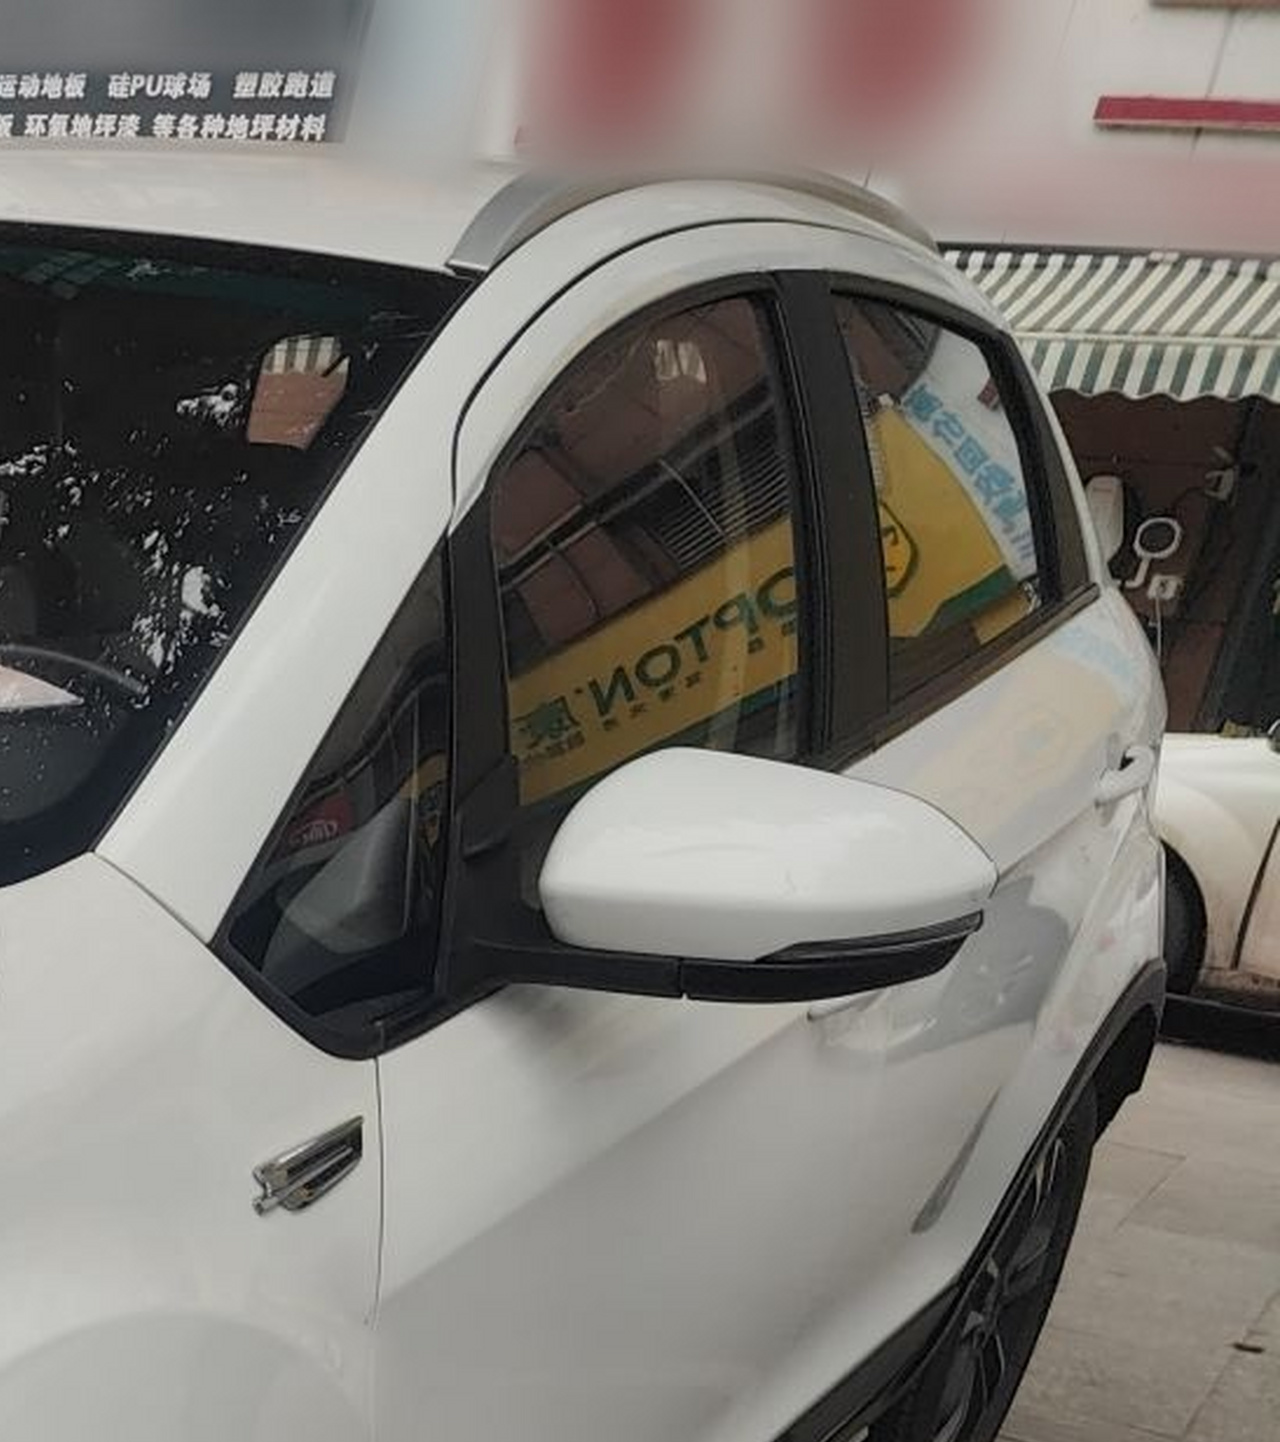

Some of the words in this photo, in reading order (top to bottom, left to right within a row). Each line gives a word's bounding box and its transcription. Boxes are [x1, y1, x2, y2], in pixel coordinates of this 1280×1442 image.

[107, 71, 212, 100] 硅PU球场
[232, 71, 336, 99] 塑胶跑道
